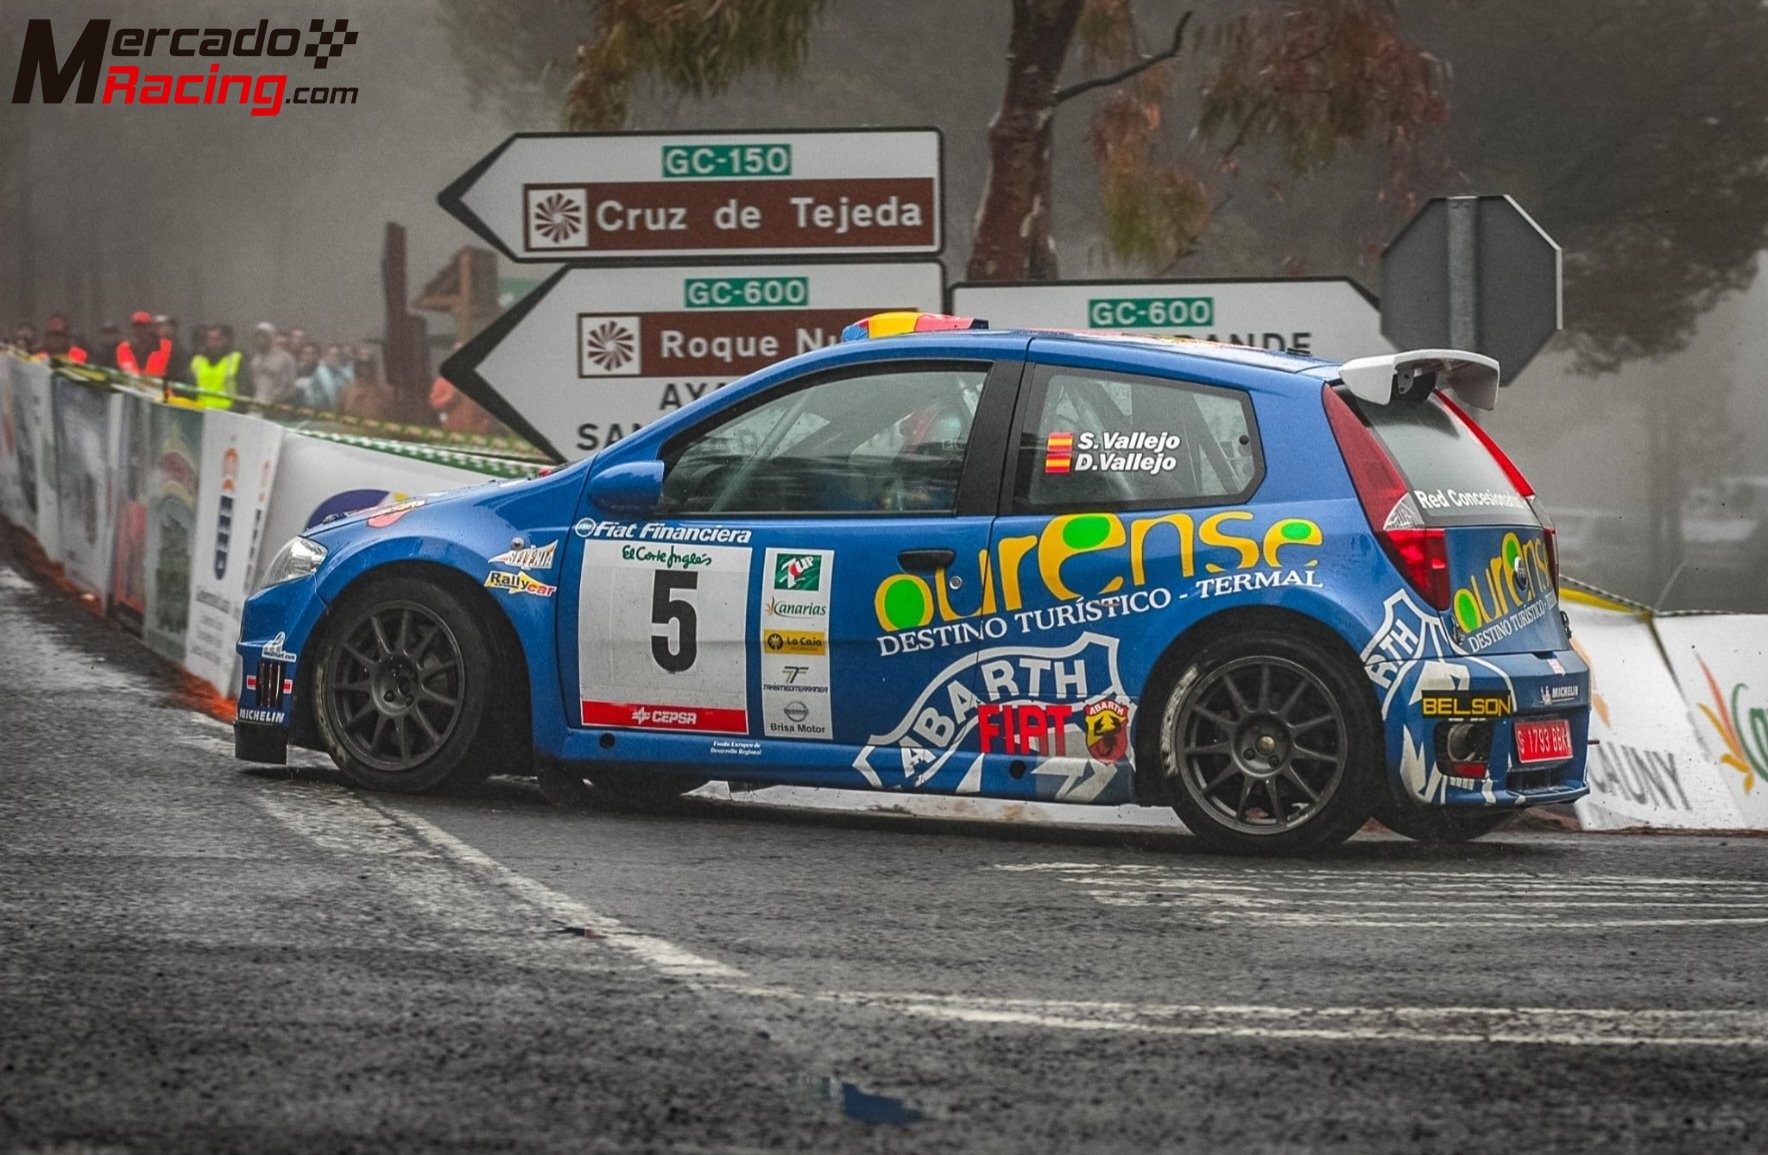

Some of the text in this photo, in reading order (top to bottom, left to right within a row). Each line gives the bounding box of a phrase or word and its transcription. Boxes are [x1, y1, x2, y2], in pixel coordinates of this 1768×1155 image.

[665, 147, 789, 174] GC-150
[596, 196, 922, 233] Cruz de Tejeda
[687, 280, 806, 305] GC-600
[1090, 300, 1211, 325] GC-600
[660, 330, 779, 363] Roque
[1077, 432, 1182, 452] S.Vallejo
[1074, 452, 1178, 473] D.Vallejo
[1413, 489, 1451, 509] Red
[593, 520, 638, 538] Fiat
[640, 523, 752, 543] Financiera
[490, 573, 556, 595] Rallycar
[874, 511, 1323, 632] ourense
[651, 568, 698, 674] 5
[773, 600, 827, 618] Canarias
[876, 617, 1007, 656] DESTINO
[1015, 588, 1172, 633] TURÍSTICO
[1196, 570, 1324, 599] TERMAL
[1468, 619, 1512, 653] DESTINO
[239, 708, 285, 723] MICHELIN
[651, 710, 697, 725] CEPSA
[897, 657, 1089, 778] ABARTH
[1089, 700, 1125, 715] ABARTH
[1422, 696, 1511, 716] BELSON
[770, 723, 826, 734] Brisa Motor
[976, 703, 1073, 757] FIAT
[1528, 728, 1550, 753] 1793
